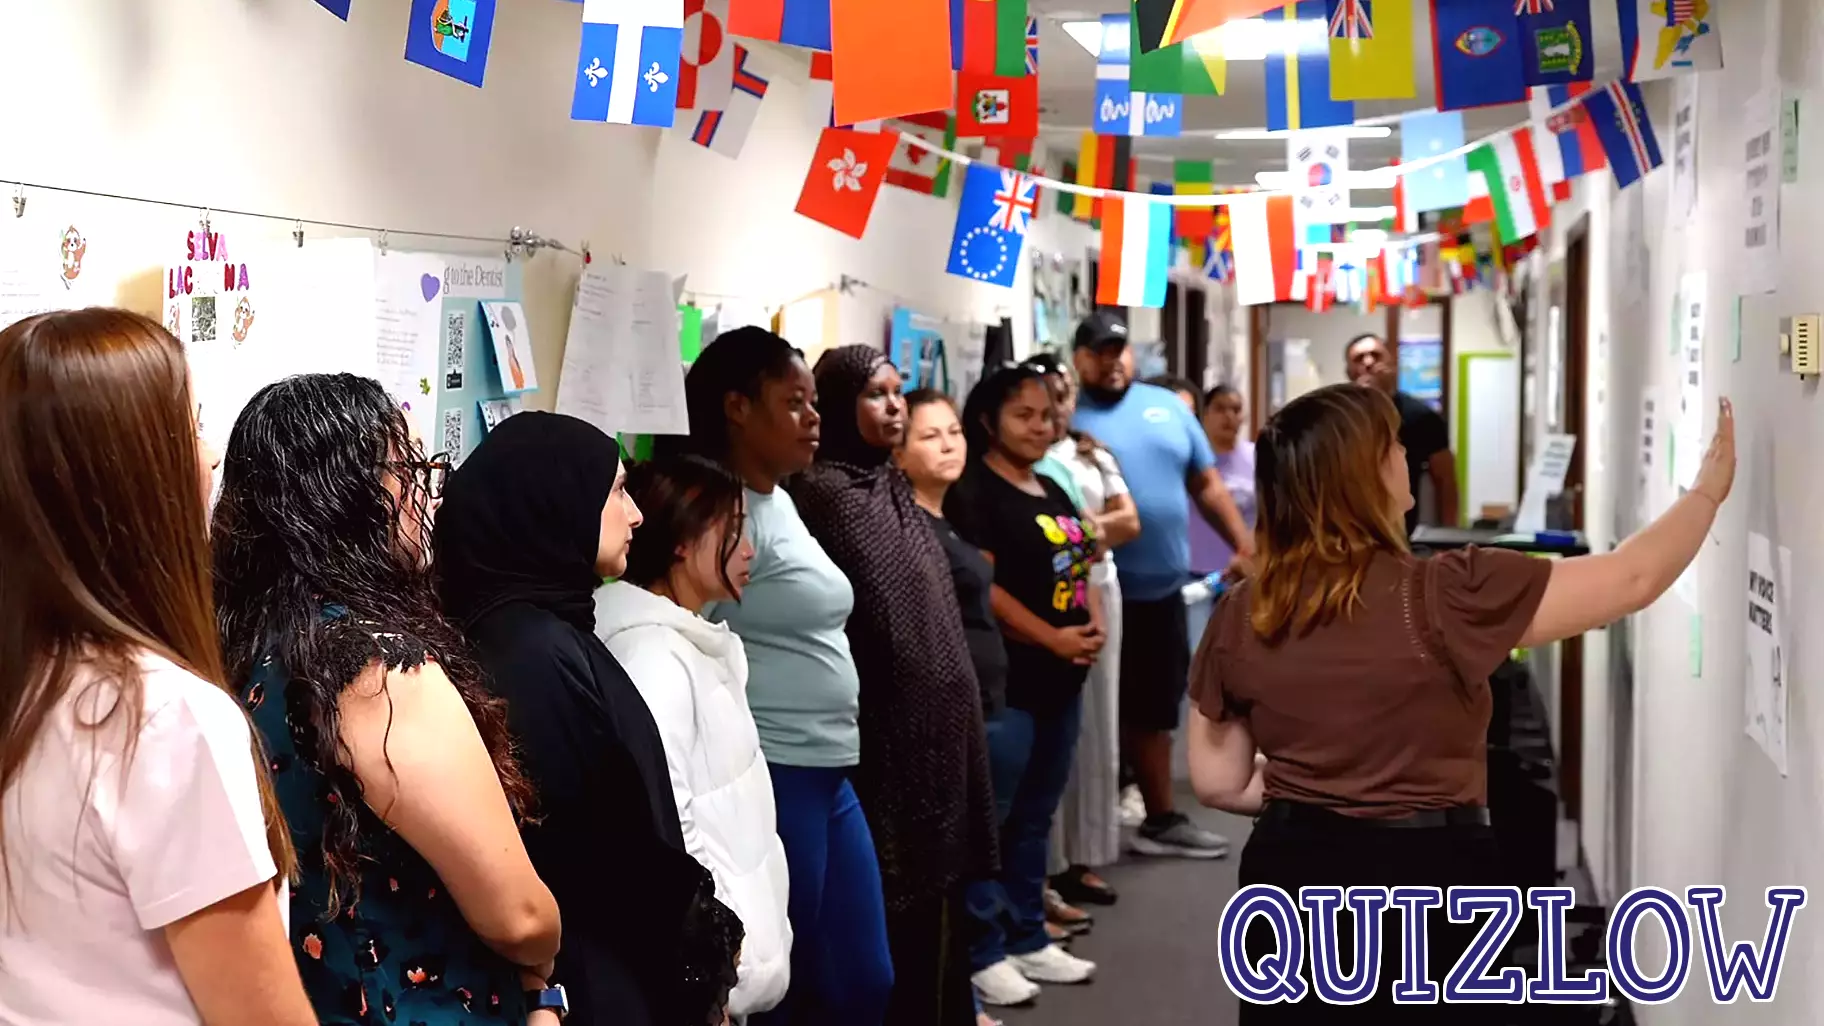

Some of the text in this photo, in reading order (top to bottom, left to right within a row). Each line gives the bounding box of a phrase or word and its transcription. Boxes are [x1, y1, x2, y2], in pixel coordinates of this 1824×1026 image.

[187, 230, 228, 261] SELVA
[451, 267, 459, 285] to
[460, 262, 473, 286] the
[475, 264, 503, 287] Dentist
